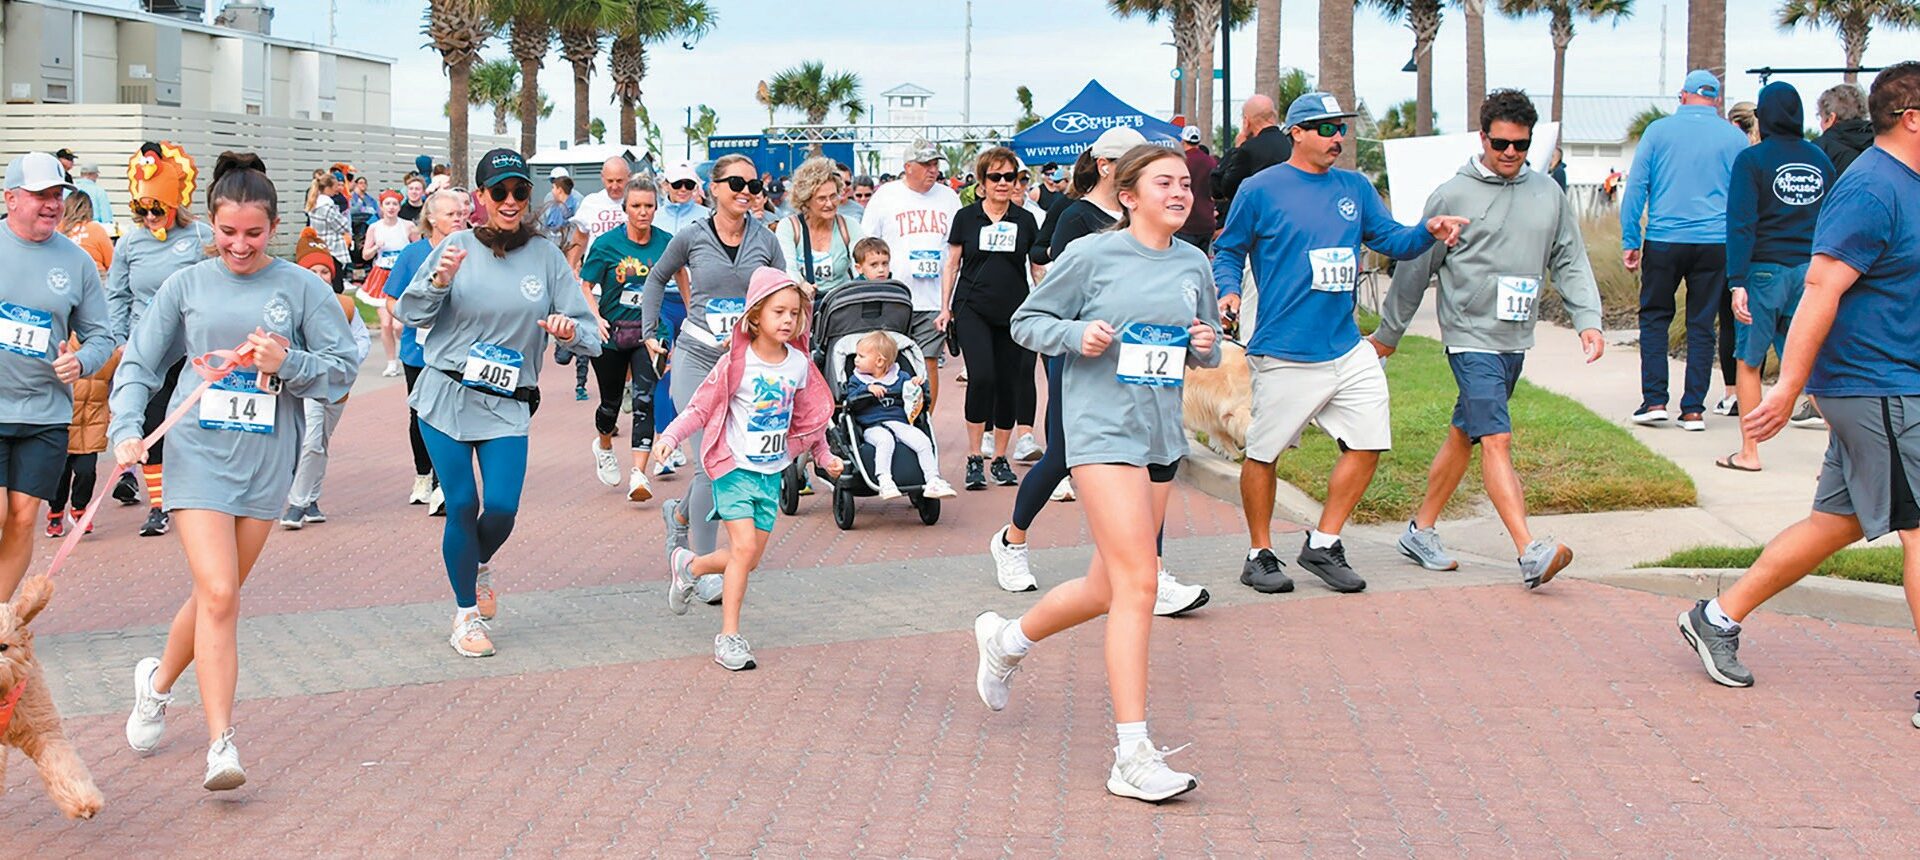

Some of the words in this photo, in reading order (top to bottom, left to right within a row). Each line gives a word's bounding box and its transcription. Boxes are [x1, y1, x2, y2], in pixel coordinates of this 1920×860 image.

[1785, 172, 1814, 183] Board
[1783, 184, 1816, 192] House
[598, 209, 622, 221] GE
[895, 209, 948, 237] TEXAS
[591, 221, 622, 234] DIR
[918, 261, 939, 273] 433
[1320, 266, 1354, 285] 1191
[1507, 295, 1532, 314] 119
[12, 327, 35, 348] 11
[1143, 350, 1169, 375] 12
[479, 364, 513, 388] 405
[228, 396, 257, 421] 14
